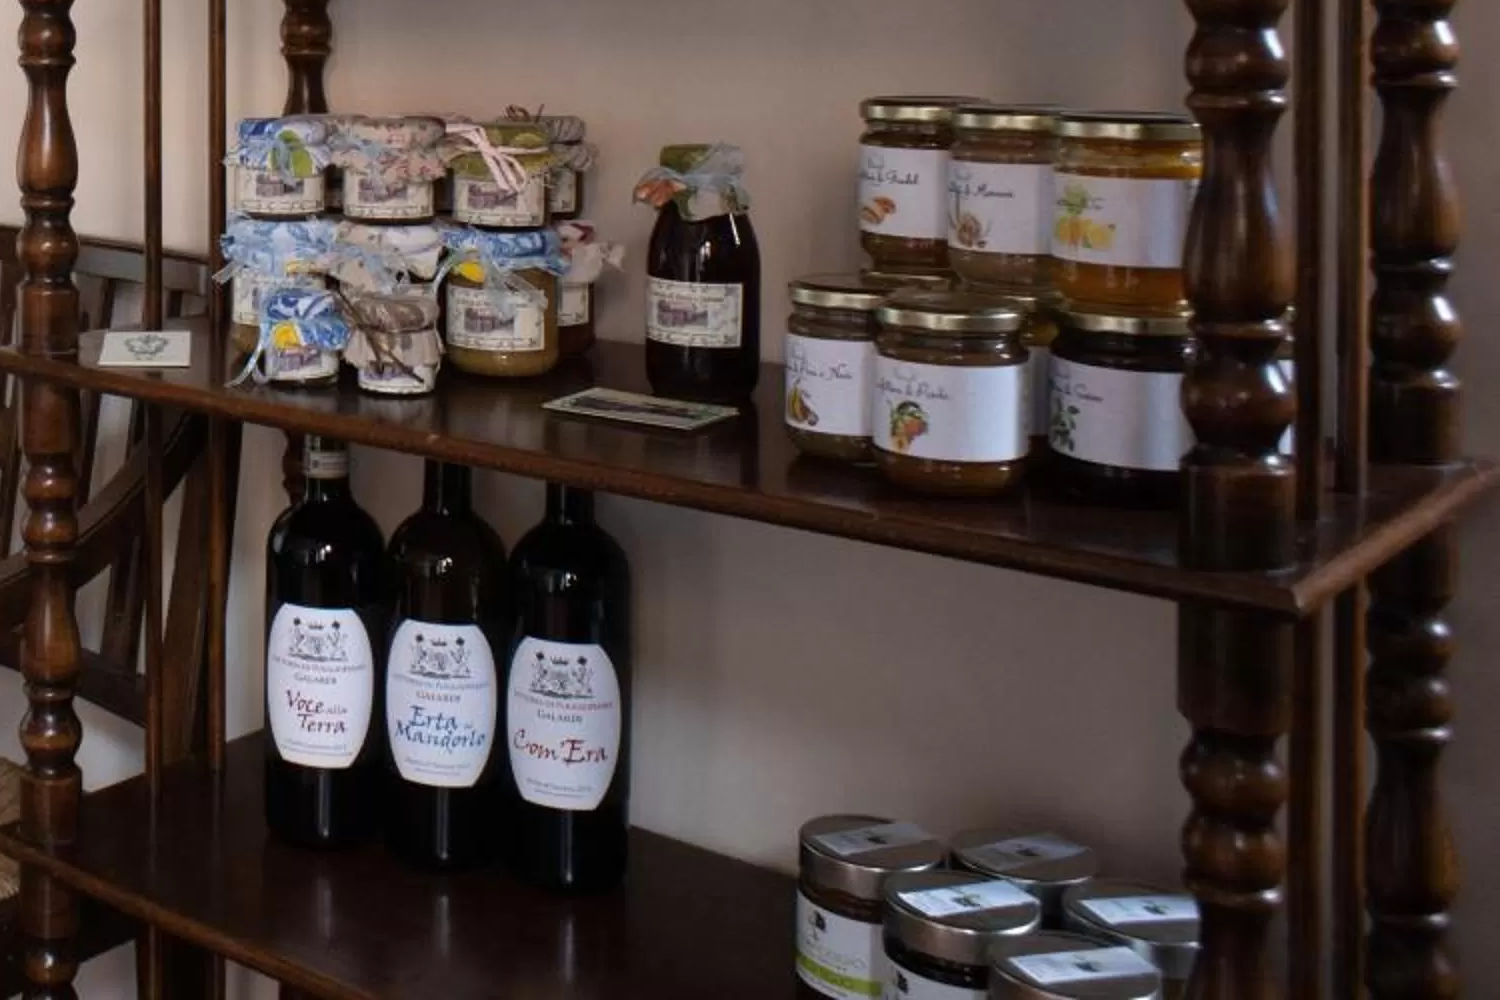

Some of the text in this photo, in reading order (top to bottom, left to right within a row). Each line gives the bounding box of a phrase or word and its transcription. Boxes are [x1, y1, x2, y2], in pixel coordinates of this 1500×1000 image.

[286, 689, 325, 713] Voce
[297, 713, 347, 734] Terra
[409, 704, 458, 731] Erta
